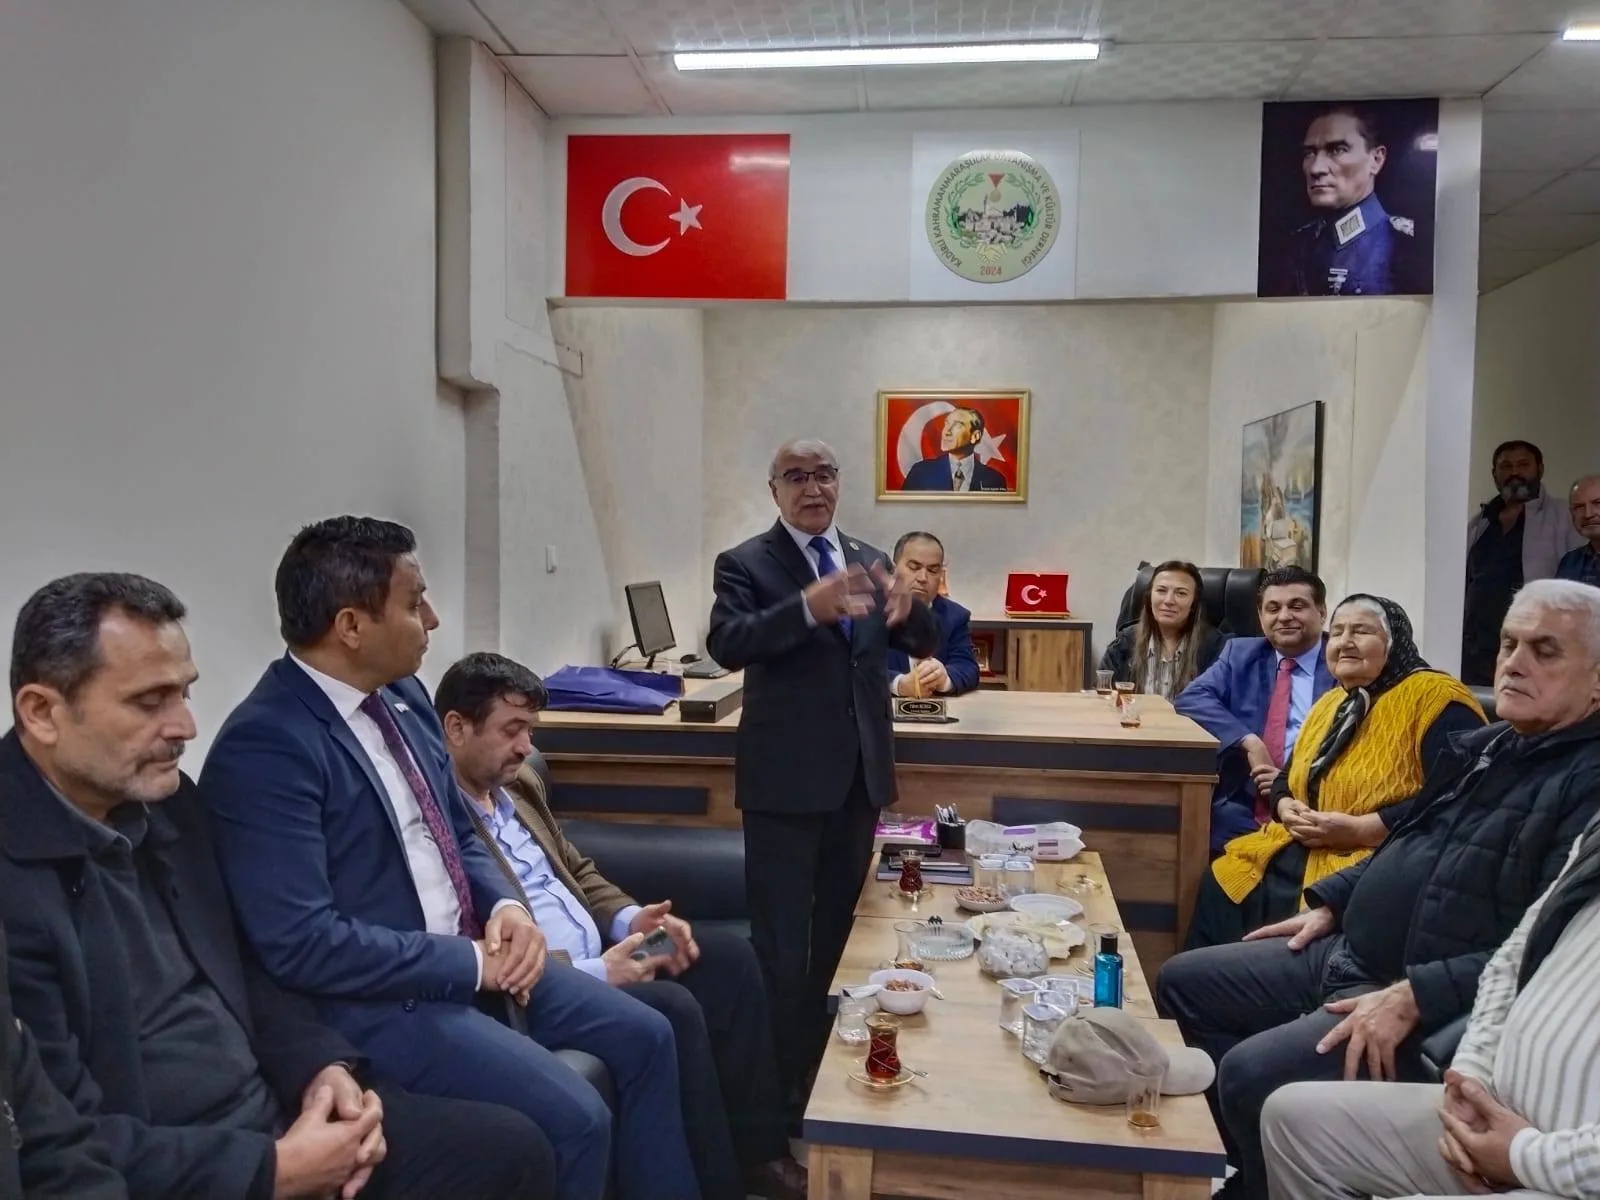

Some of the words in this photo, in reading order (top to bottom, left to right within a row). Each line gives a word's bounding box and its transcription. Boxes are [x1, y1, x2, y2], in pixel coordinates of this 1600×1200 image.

[1040, 182, 1050, 194] VE
[1044, 195, 1056, 230] KÜLTÜR
[979, 266, 1002, 276] 2024
